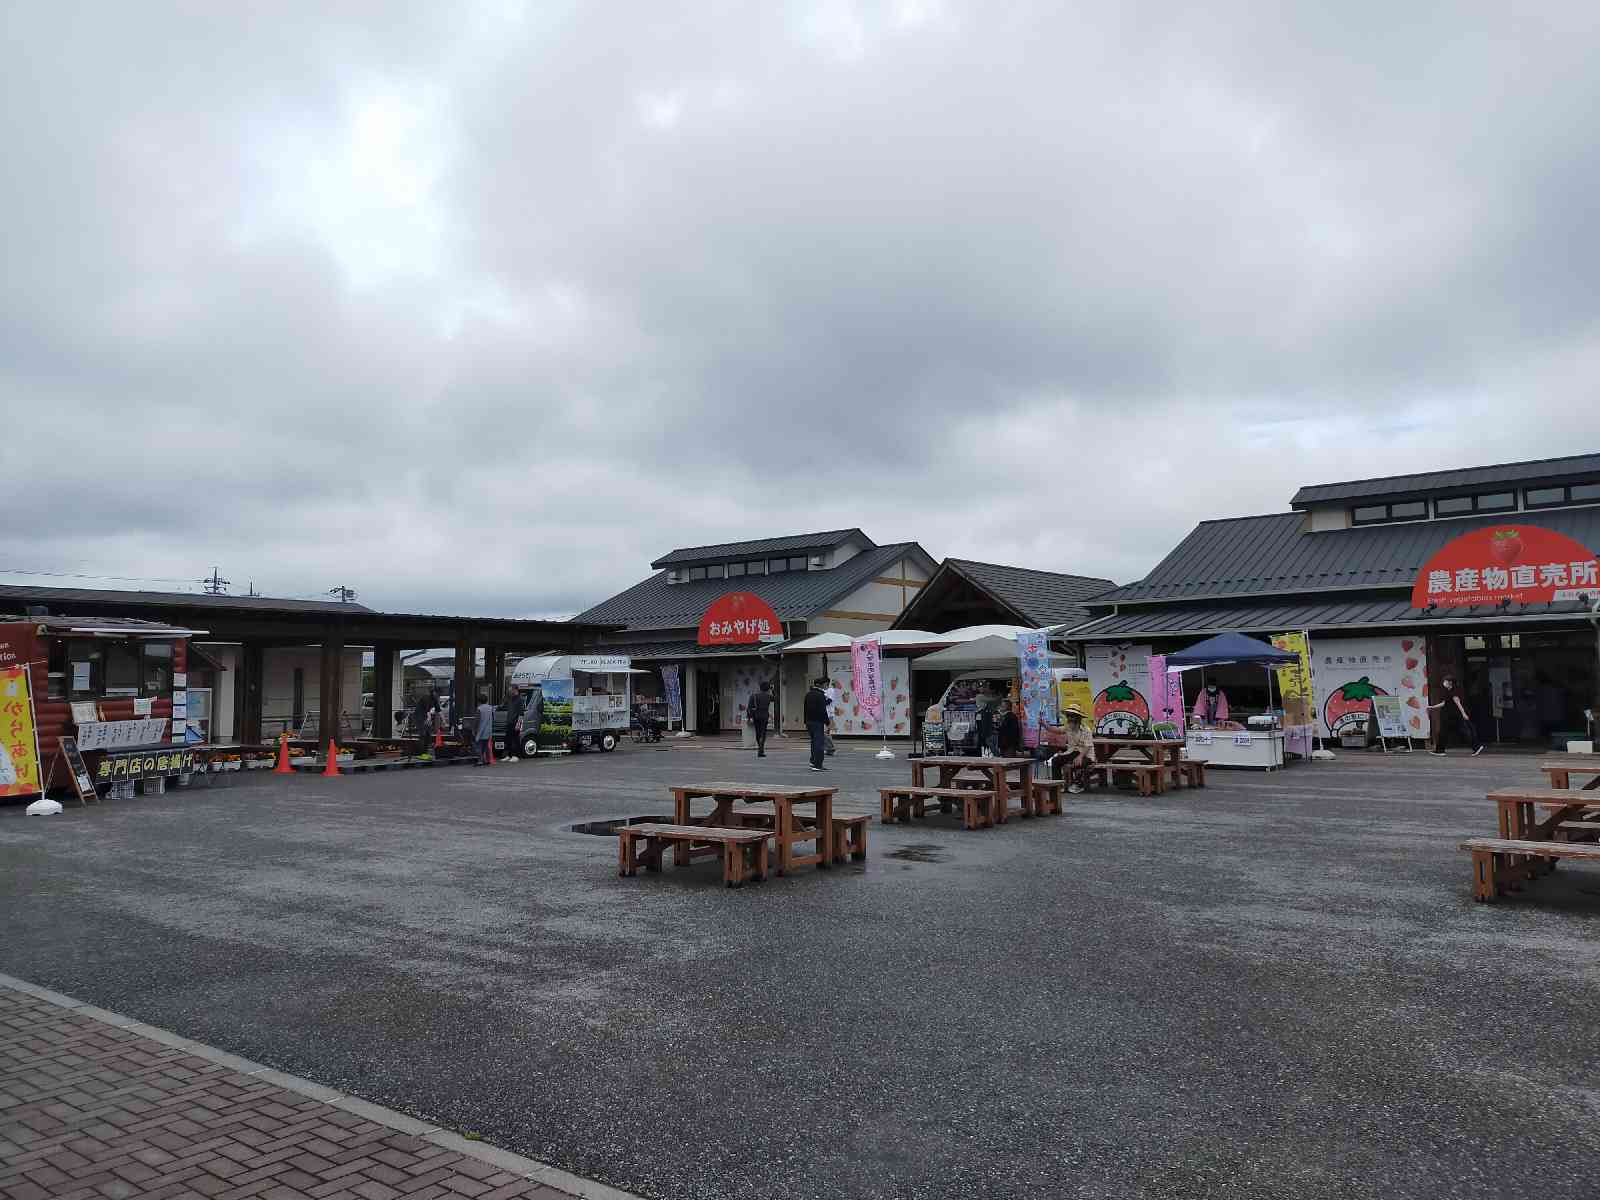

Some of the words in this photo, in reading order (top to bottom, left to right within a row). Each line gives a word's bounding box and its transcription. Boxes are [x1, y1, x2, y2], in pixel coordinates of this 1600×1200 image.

[1428, 560, 1598, 593] 農産物直売所
[709, 619, 770, 636] おみやげ処
[98, 752, 194, 777] 専門店の唐揚げ
